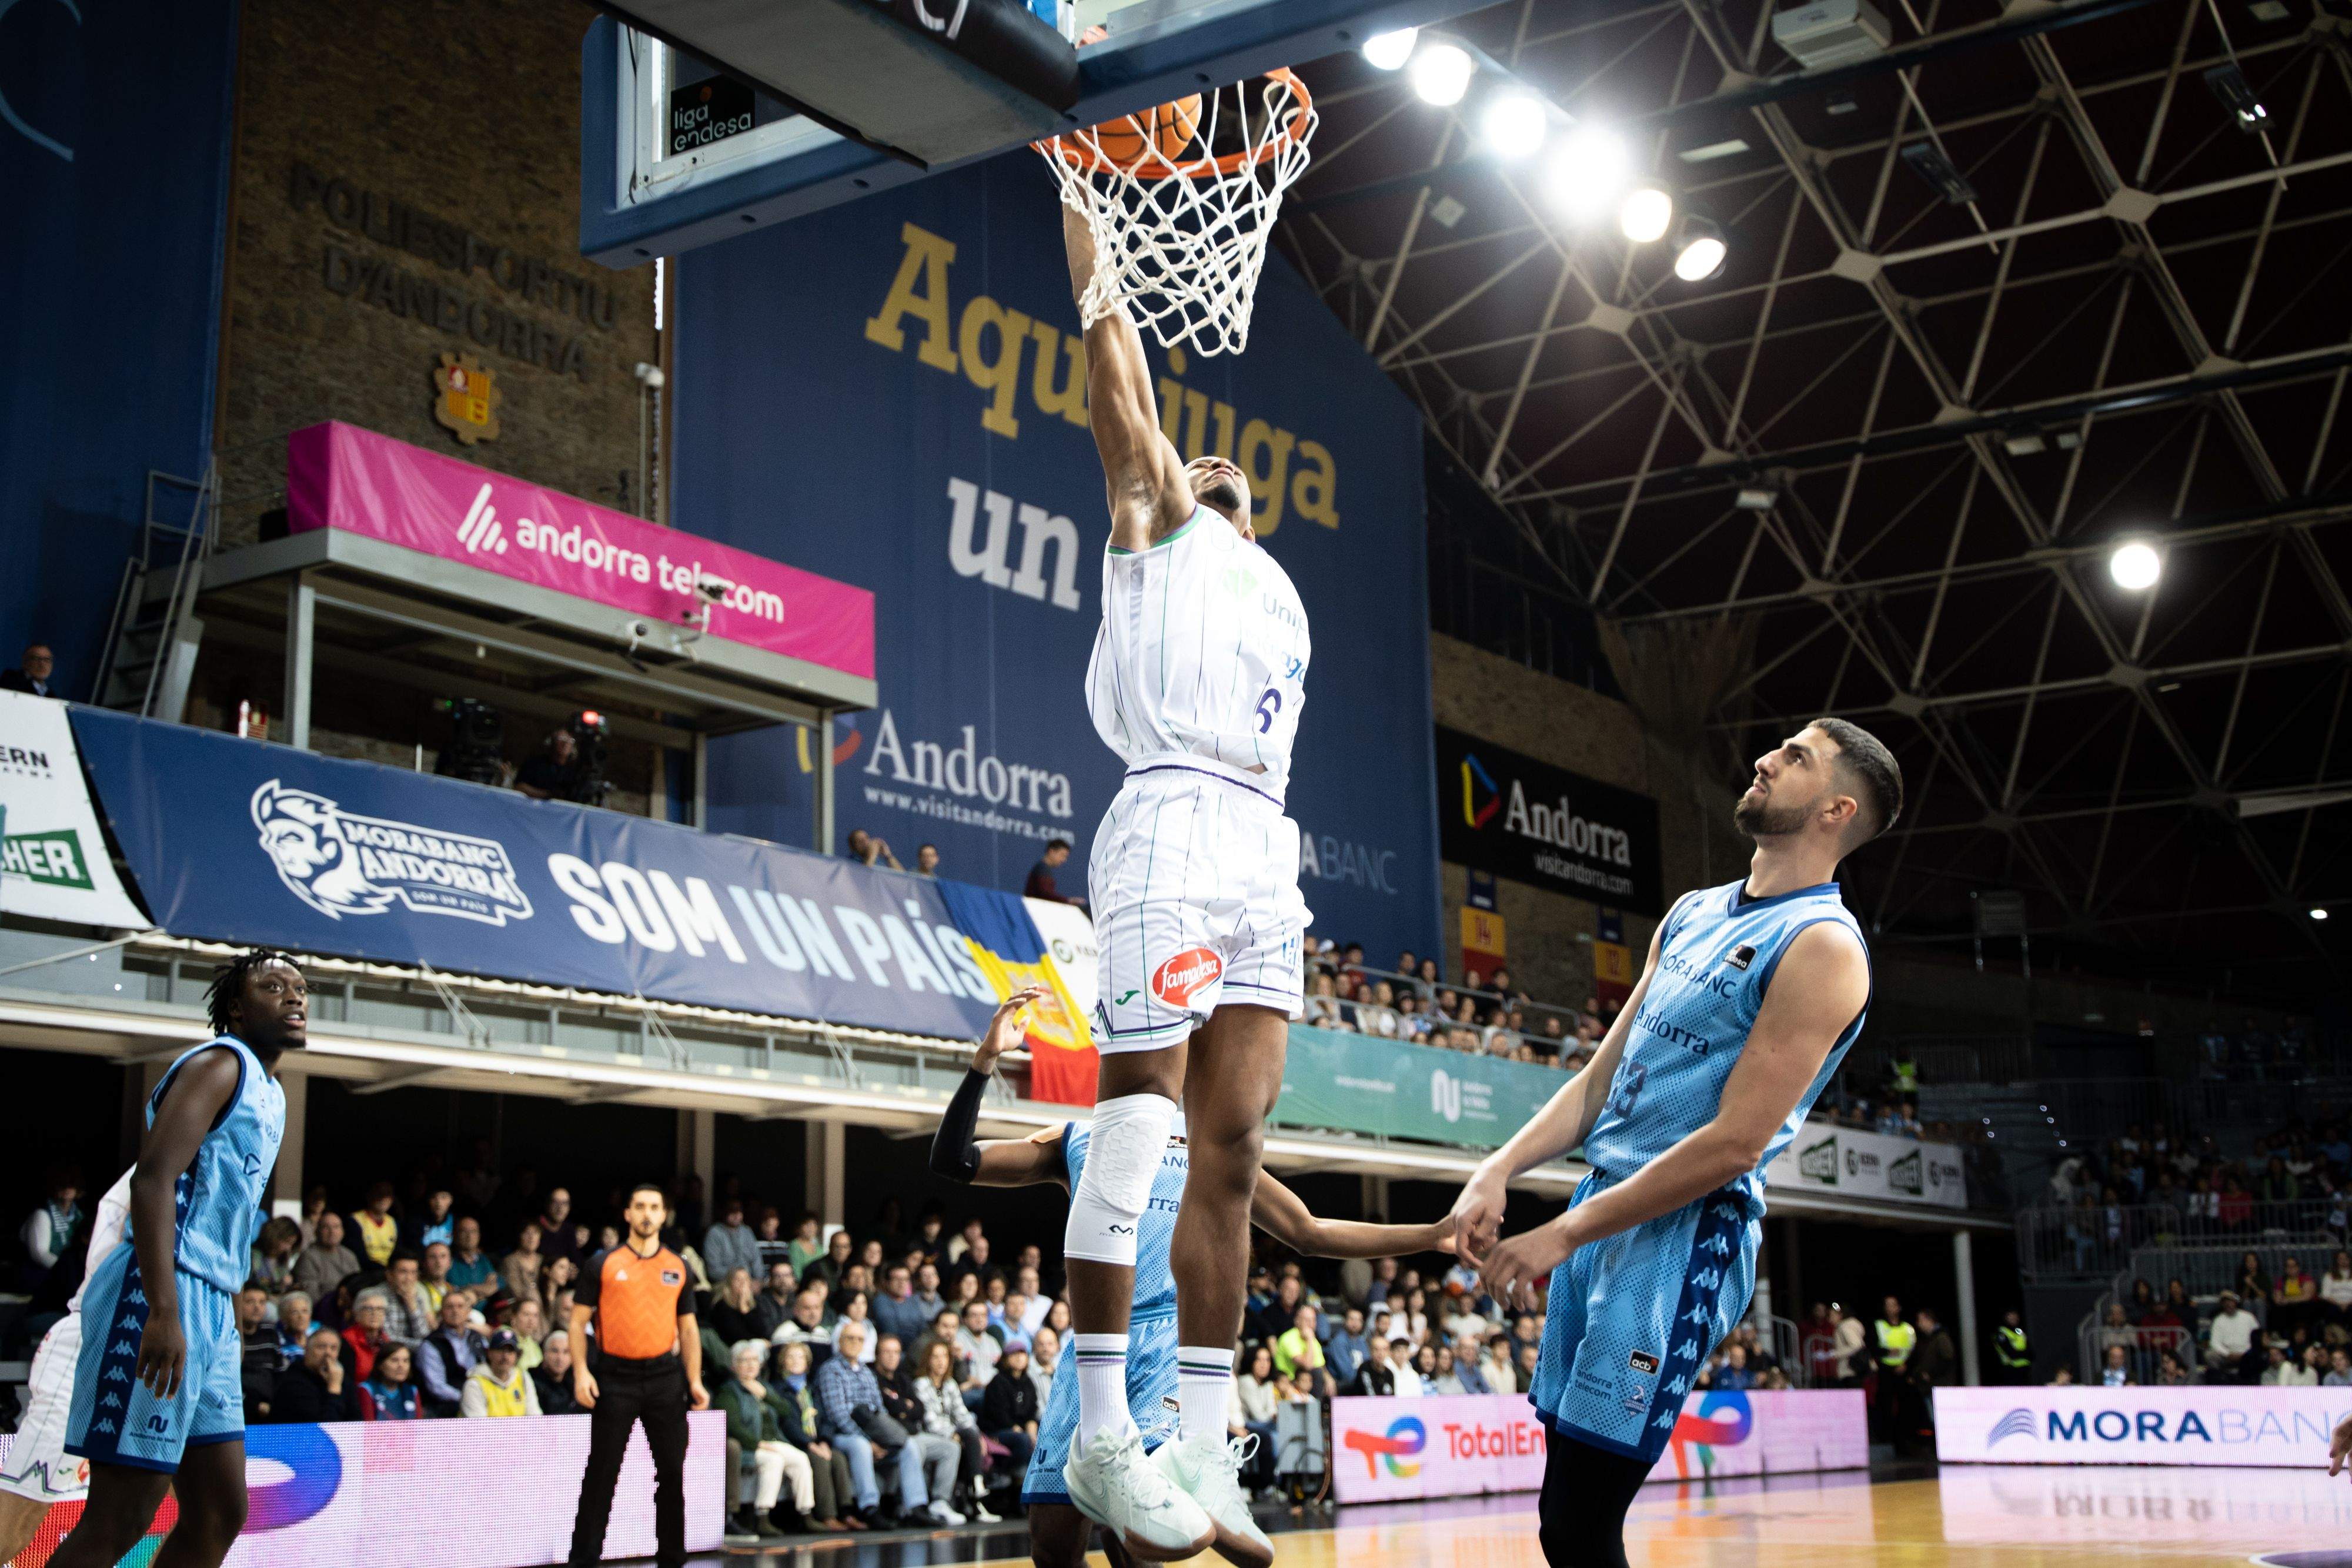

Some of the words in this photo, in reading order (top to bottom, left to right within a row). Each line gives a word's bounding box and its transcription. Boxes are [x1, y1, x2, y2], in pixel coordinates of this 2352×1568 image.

[674, 105, 709, 130] liga
[674, 112, 751, 152] endesa
[948, 477, 1080, 611] un
[516, 518, 650, 583] andorra
[657, 554, 784, 623] telcom
[863, 708, 1073, 818] Andorra
[341, 821, 503, 870] MORABANC
[1504, 779, 1632, 868] Andorra
[359, 845, 522, 907] ANDORRA
[547, 852, 748, 964] SOM
[727, 885, 857, 982] UN
[1158, 951, 1218, 998] famadesa
[1635, 1002, 1710, 1055] Andorra
[1576, 1369, 1612, 1389] andorra
[1632, 1358, 1652, 1371] acb
[1575, 1379, 1612, 1400] telecom
[2047, 1408, 2352, 1443] MORABAN
